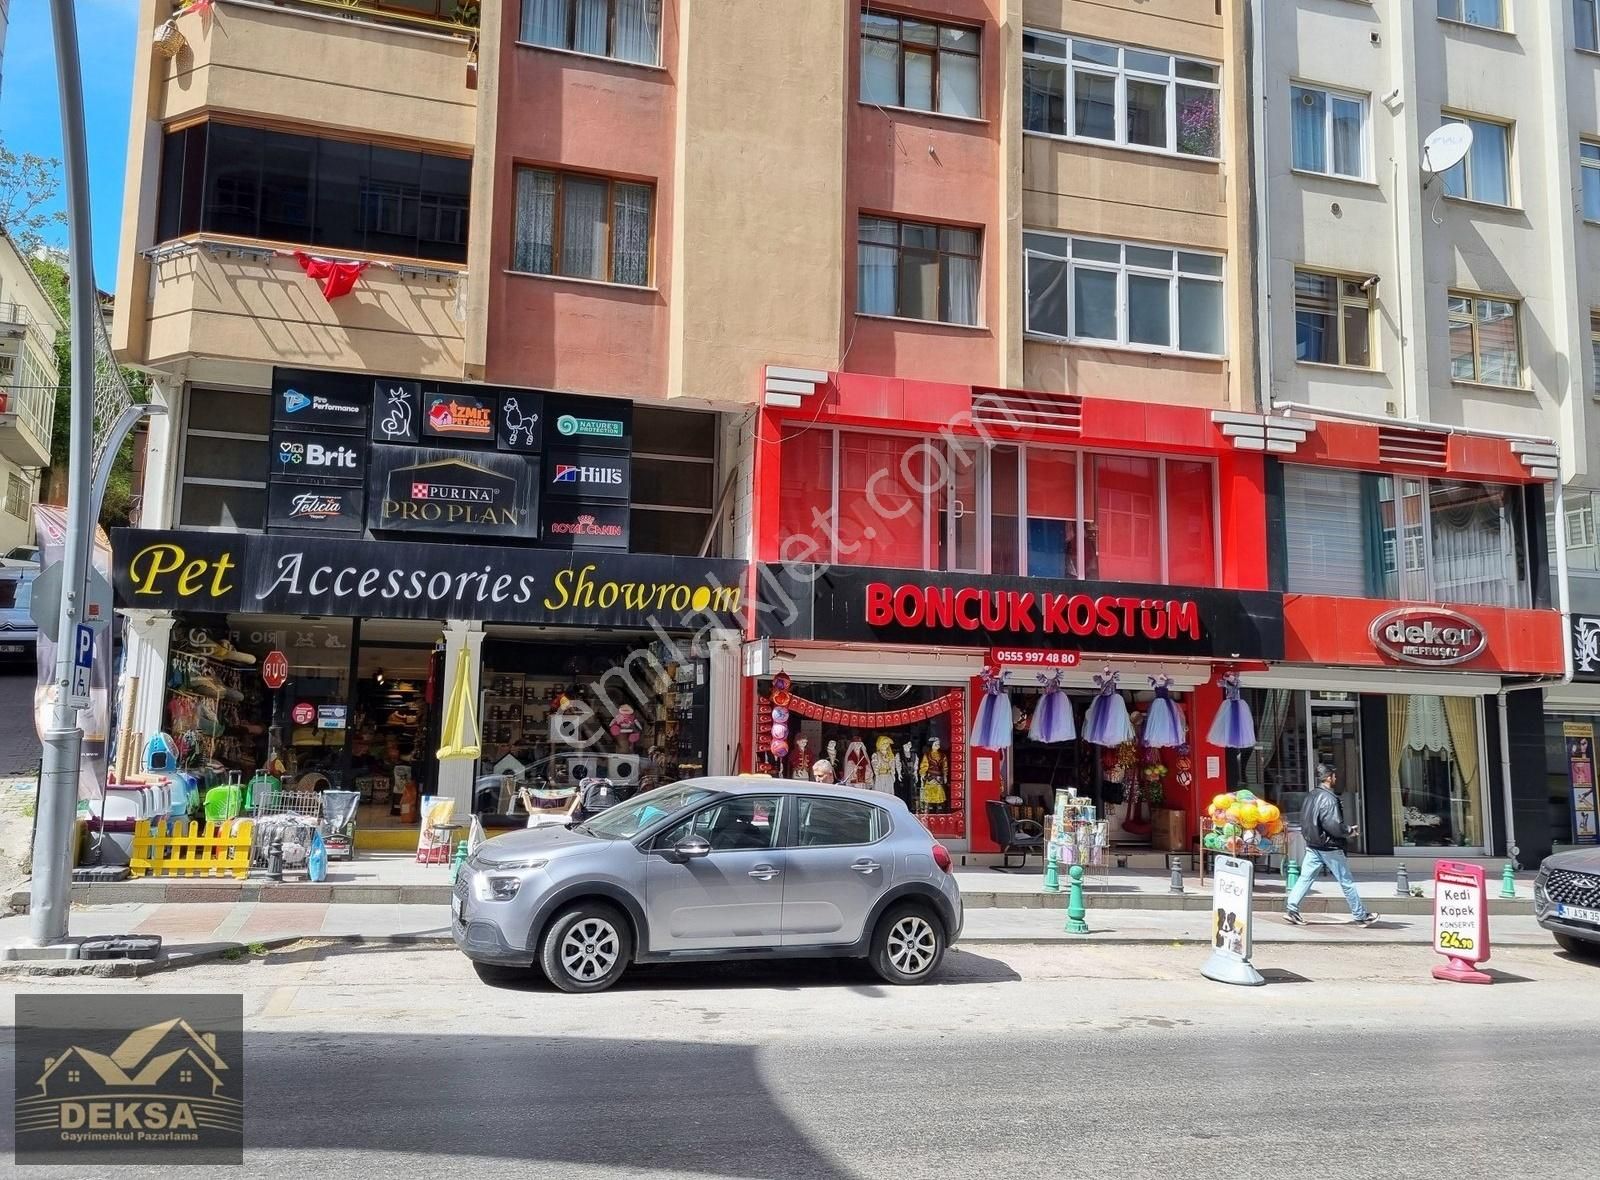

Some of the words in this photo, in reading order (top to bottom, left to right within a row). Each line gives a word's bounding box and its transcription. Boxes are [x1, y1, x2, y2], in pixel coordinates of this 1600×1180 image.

[312, 402, 359, 413] Performance
[452, 417, 468, 426] PET
[468, 418, 490, 427] SHOP
[579, 421, 619, 430] NATURE'S
[579, 426, 619, 434] PROTECTION
[306, 443, 357, 468] Brit
[580, 466, 622, 485] Hill's
[430, 486, 490, 501] PURINA
[289, 491, 341, 516] Felicia
[383, 500, 441, 521] PRO
[447, 504, 518, 526] PLAN
[551, 523, 586, 535] ROYAL
[586, 523, 622, 536] CANIN
[129, 543, 236, 597] Pet
[255, 552, 535, 604] Accessories
[544, 564, 742, 614] Showroom
[865, 582, 1036, 632] BONCUK
[1041, 592, 1200, 641] KOSTÜM
[1385, 619, 1475, 646] dekor
[79, 630, 91, 663] P
[997, 651, 1024, 662] 0555
[1025, 652, 1044, 662] 997
[1046, 653, 1059, 663] 48
[1061, 654, 1075, 664] 80
[1444, 889, 1471, 901] Kedi
